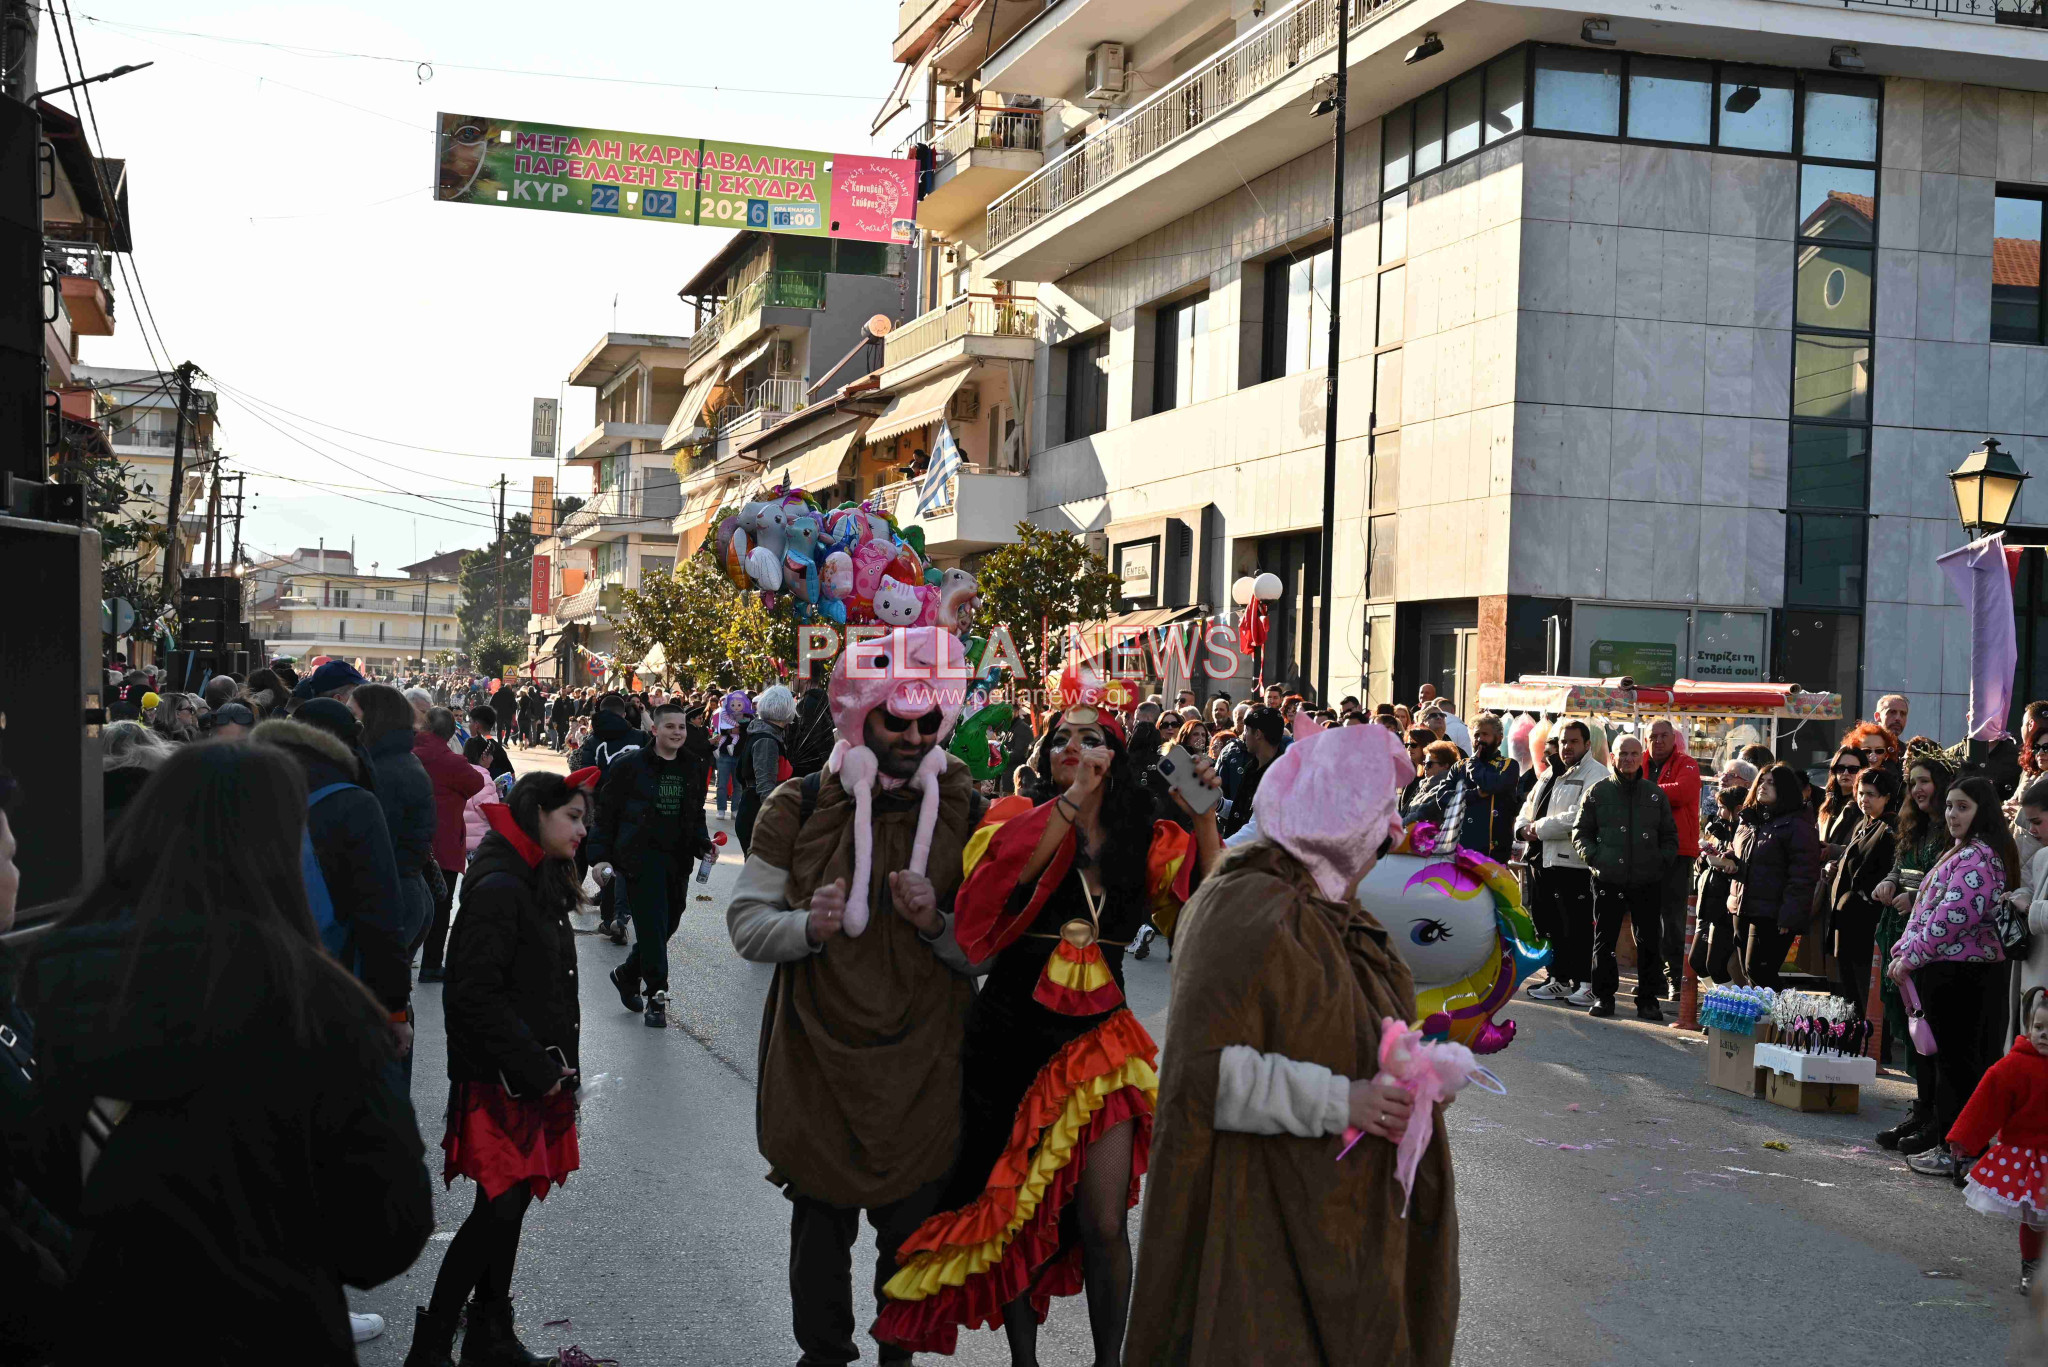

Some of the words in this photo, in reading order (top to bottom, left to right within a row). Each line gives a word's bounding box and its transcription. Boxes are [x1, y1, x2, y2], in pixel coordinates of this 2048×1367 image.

[515, 132, 622, 161] ΜΕΓΑΛΗ
[628, 143, 816, 180] ΚΑΡΝΑΒΑΛΙΚΗ
[514, 154, 657, 188] ΠΑΡΕΛΑΣΗ
[662, 169, 712, 192] ΣΤΗ
[718, 174, 817, 202] ΣΚΥΔΡΑ
[700, 198, 765, 223] 2026
[774, 212, 815, 226] 16:00
[536, 561, 546, 610] HOTEL
[1697, 651, 1740, 663] Στηρίζει
[1743, 654, 1755, 664] τη
[1697, 665, 1733, 675] σοδειά
[1735, 667, 1758, 676] σου!
